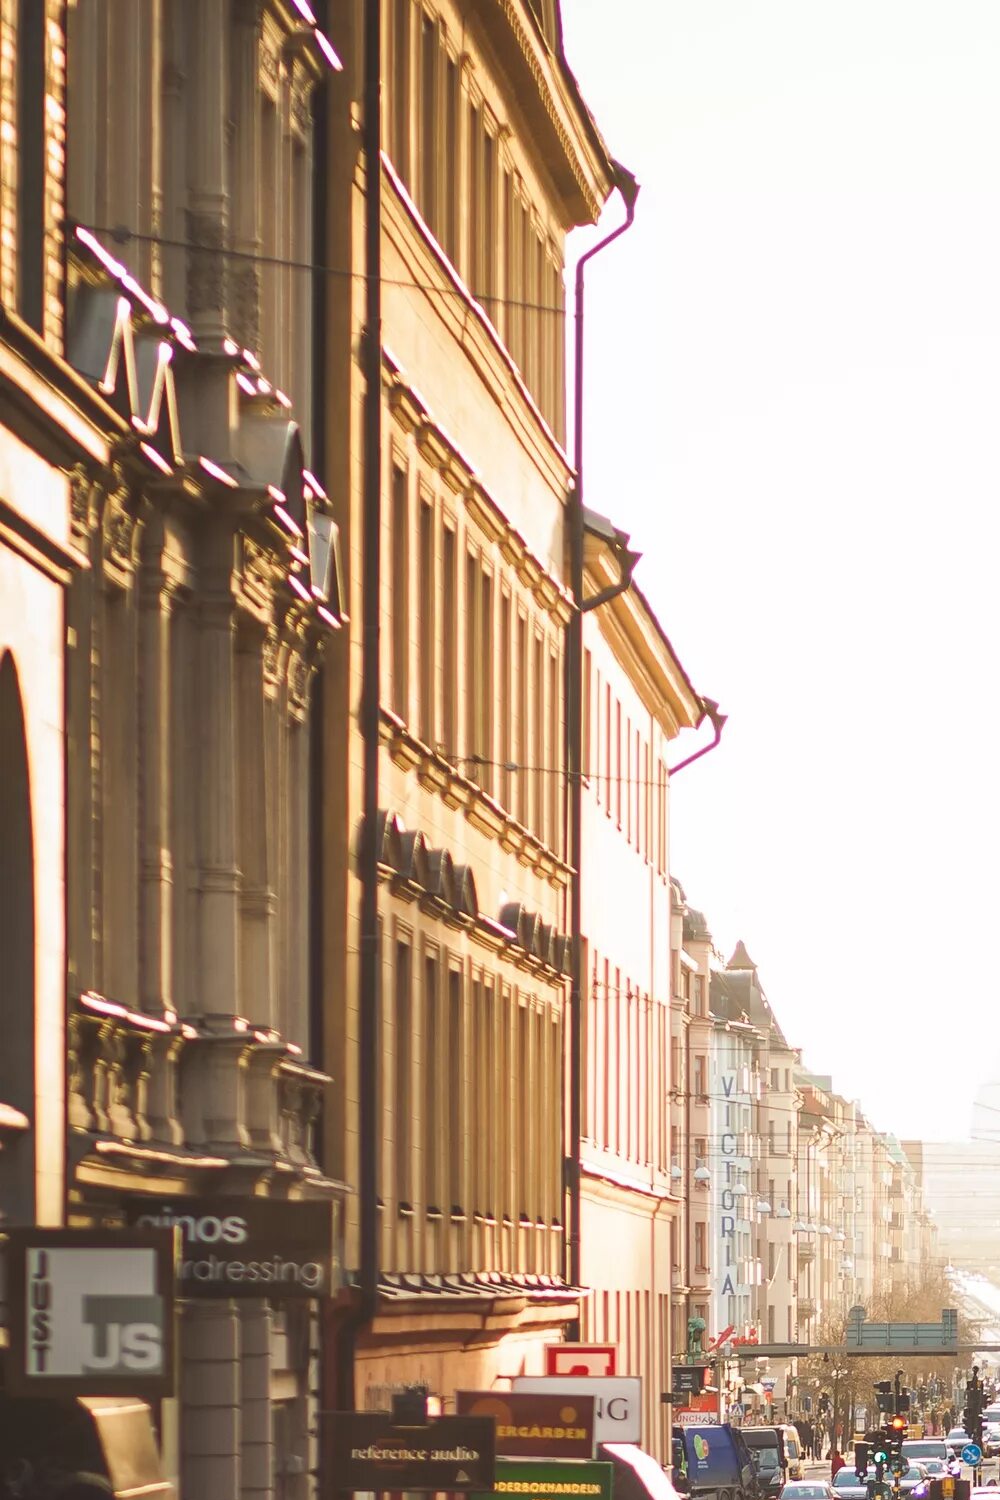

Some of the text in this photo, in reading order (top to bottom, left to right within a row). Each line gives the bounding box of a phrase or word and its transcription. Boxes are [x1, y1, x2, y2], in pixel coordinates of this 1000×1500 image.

[721, 1076, 736, 1296] VICTORIA
[32, 1250, 51, 1373] JUST
[83, 1322, 163, 1370] US
[351, 1444, 480, 1462] reference audio
[494, 1481, 602, 1495] DERBOKHANDELN
